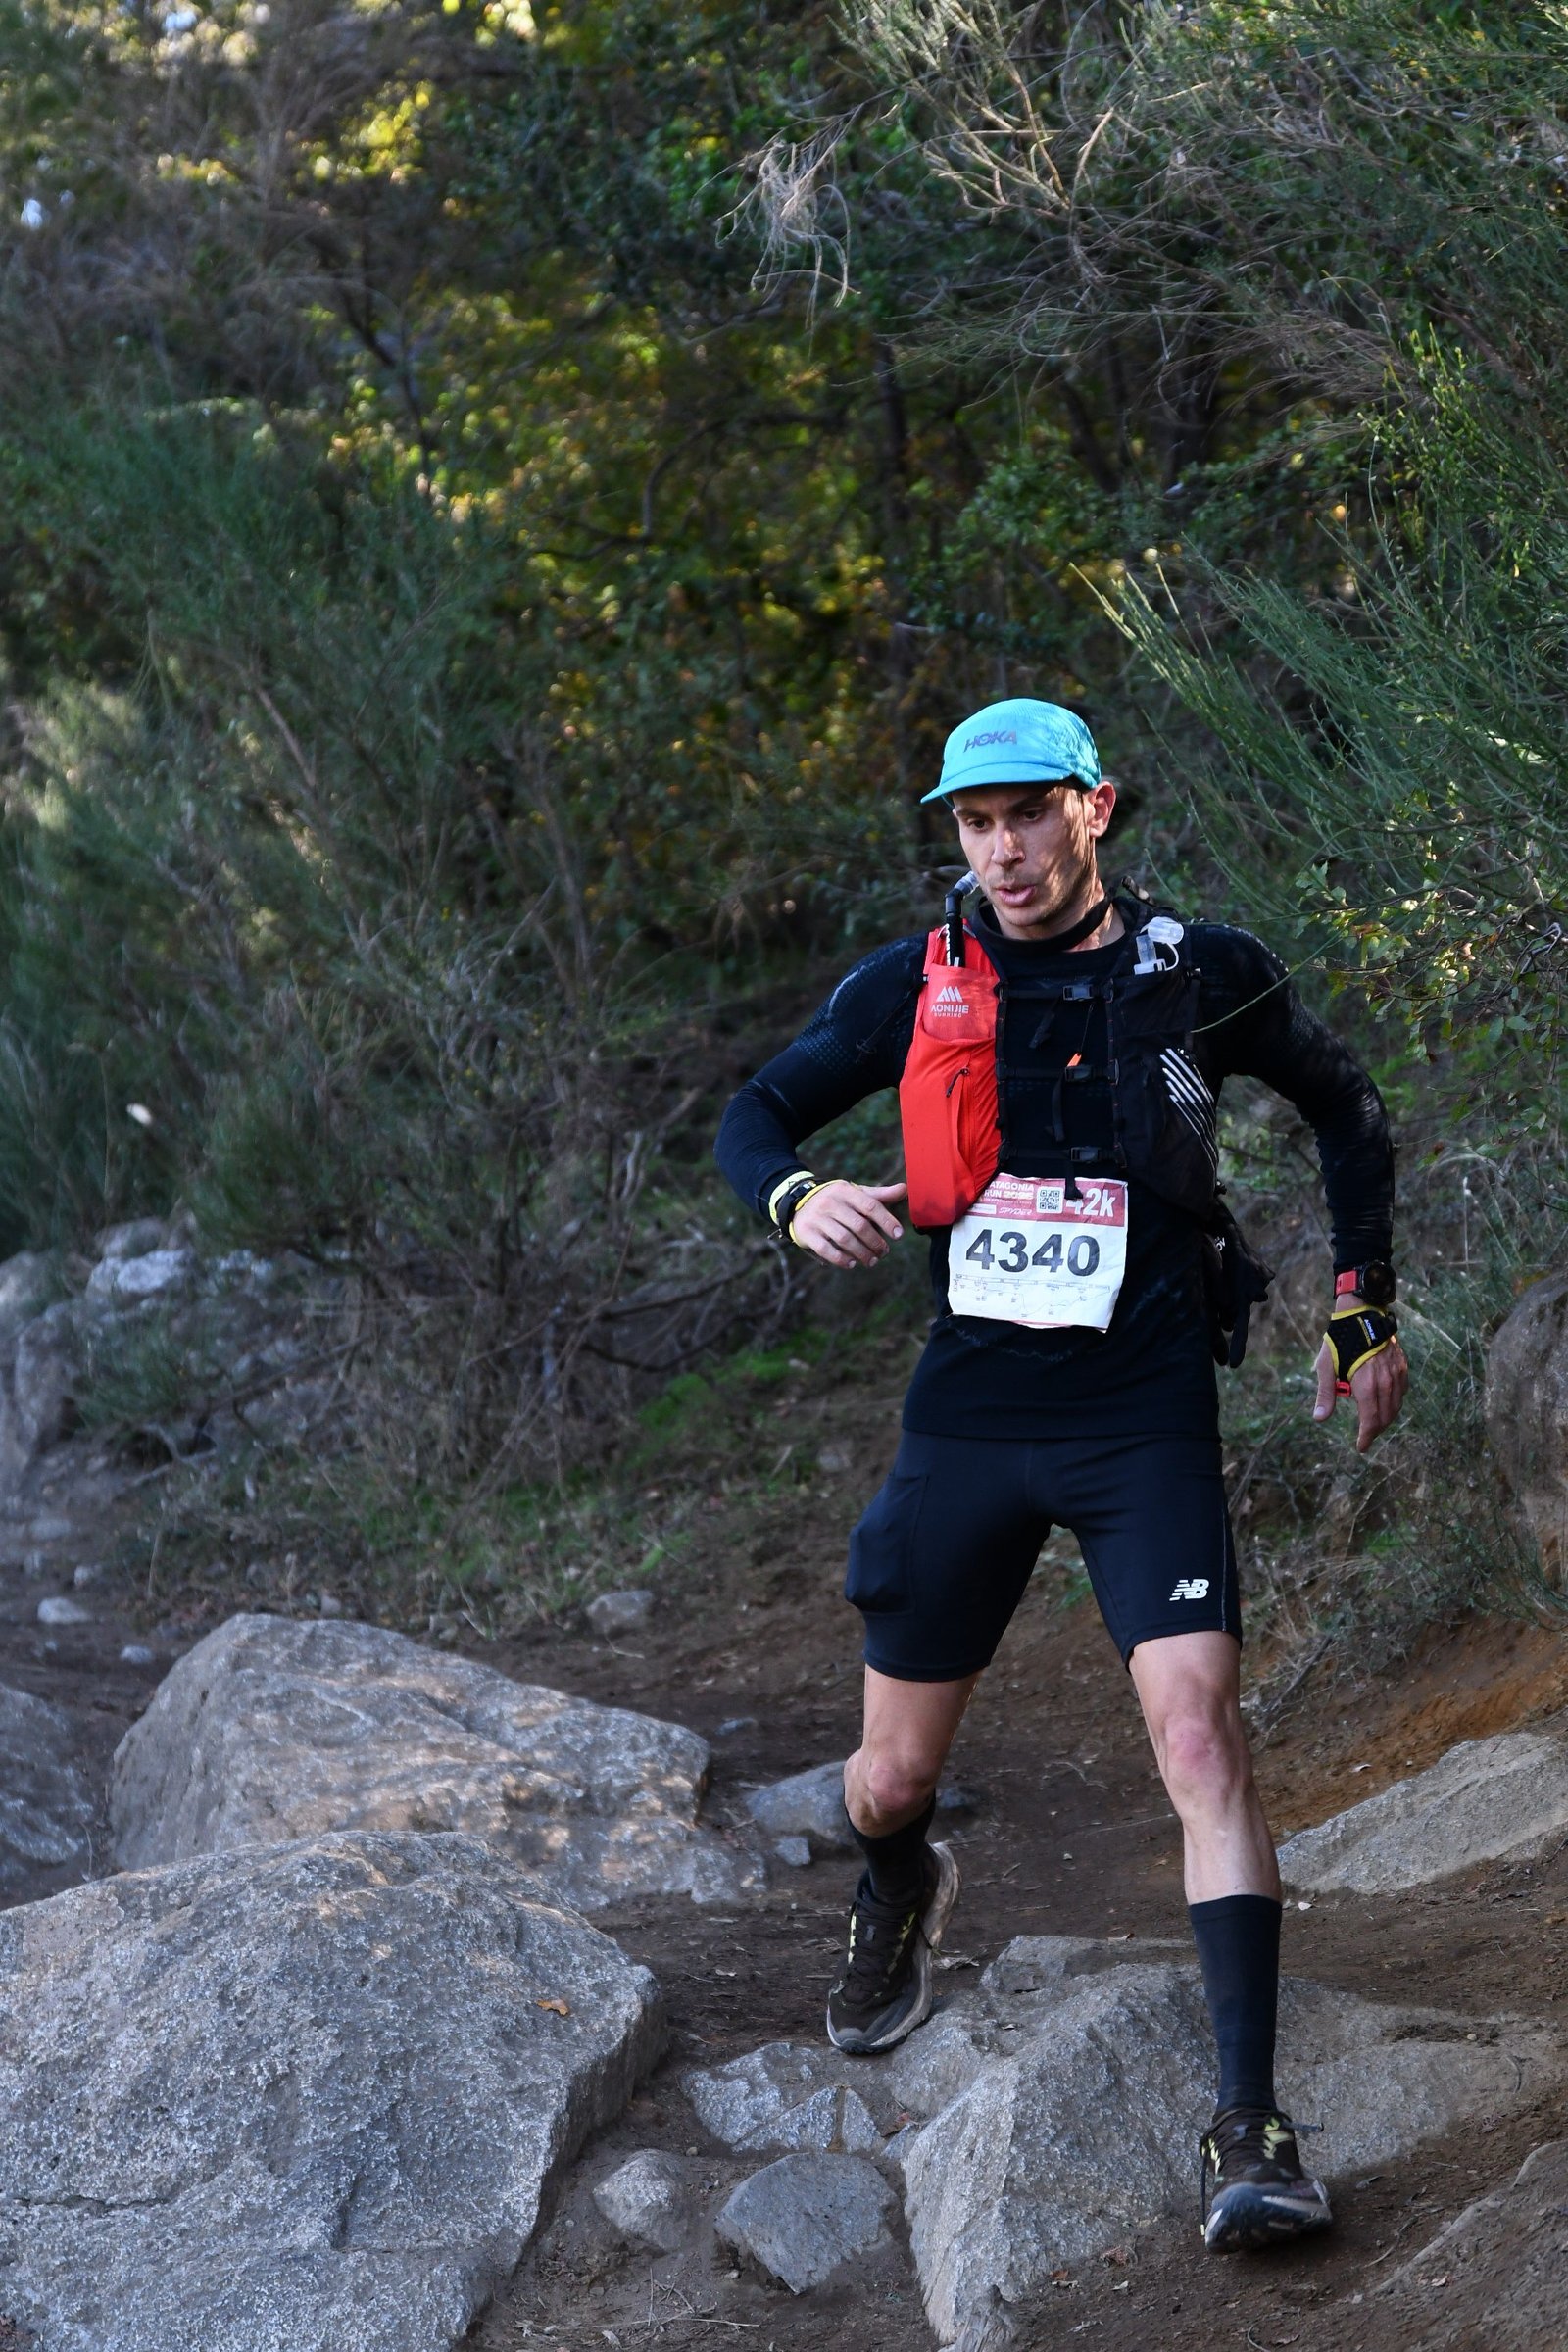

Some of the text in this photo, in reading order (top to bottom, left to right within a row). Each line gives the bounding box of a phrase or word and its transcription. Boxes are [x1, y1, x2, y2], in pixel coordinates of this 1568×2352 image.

[963, 731, 1017, 753] HOKA
[931, 1004, 969, 1014] AONIJIE
[989, 1180, 1034, 1192] ATAGONIA
[984, 1189, 1002, 1198] RUN
[965, 1228, 1100, 1277] 4340
